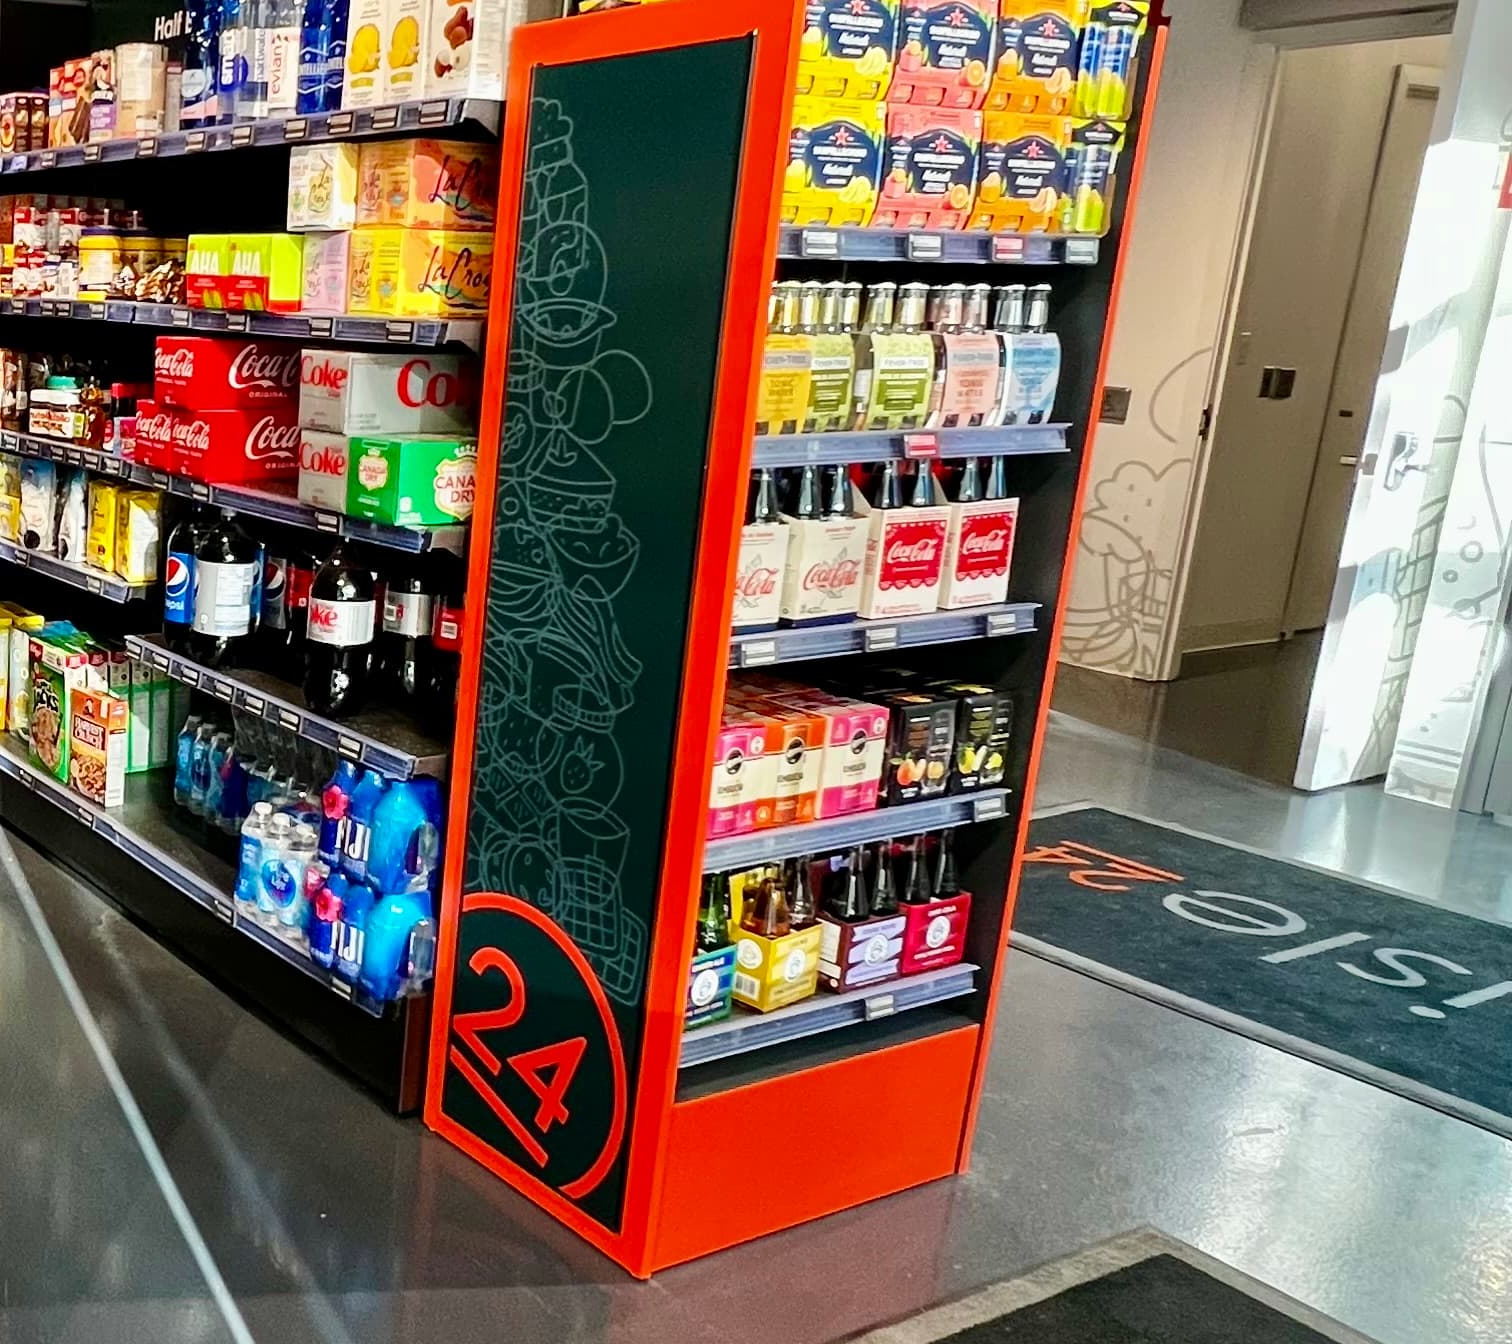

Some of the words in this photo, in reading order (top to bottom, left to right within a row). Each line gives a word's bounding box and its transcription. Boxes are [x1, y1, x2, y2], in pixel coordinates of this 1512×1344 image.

[154, 10, 183, 41] Half
[271, 41, 285, 95] evian
[191, 251, 219, 274] AHA
[233, 251, 261, 275] AHA
[301, 355, 348, 390] Coke
[300, 442, 346, 476] Coke
[435, 474, 476, 489] CANA
[453, 946, 587, 1134] 24
